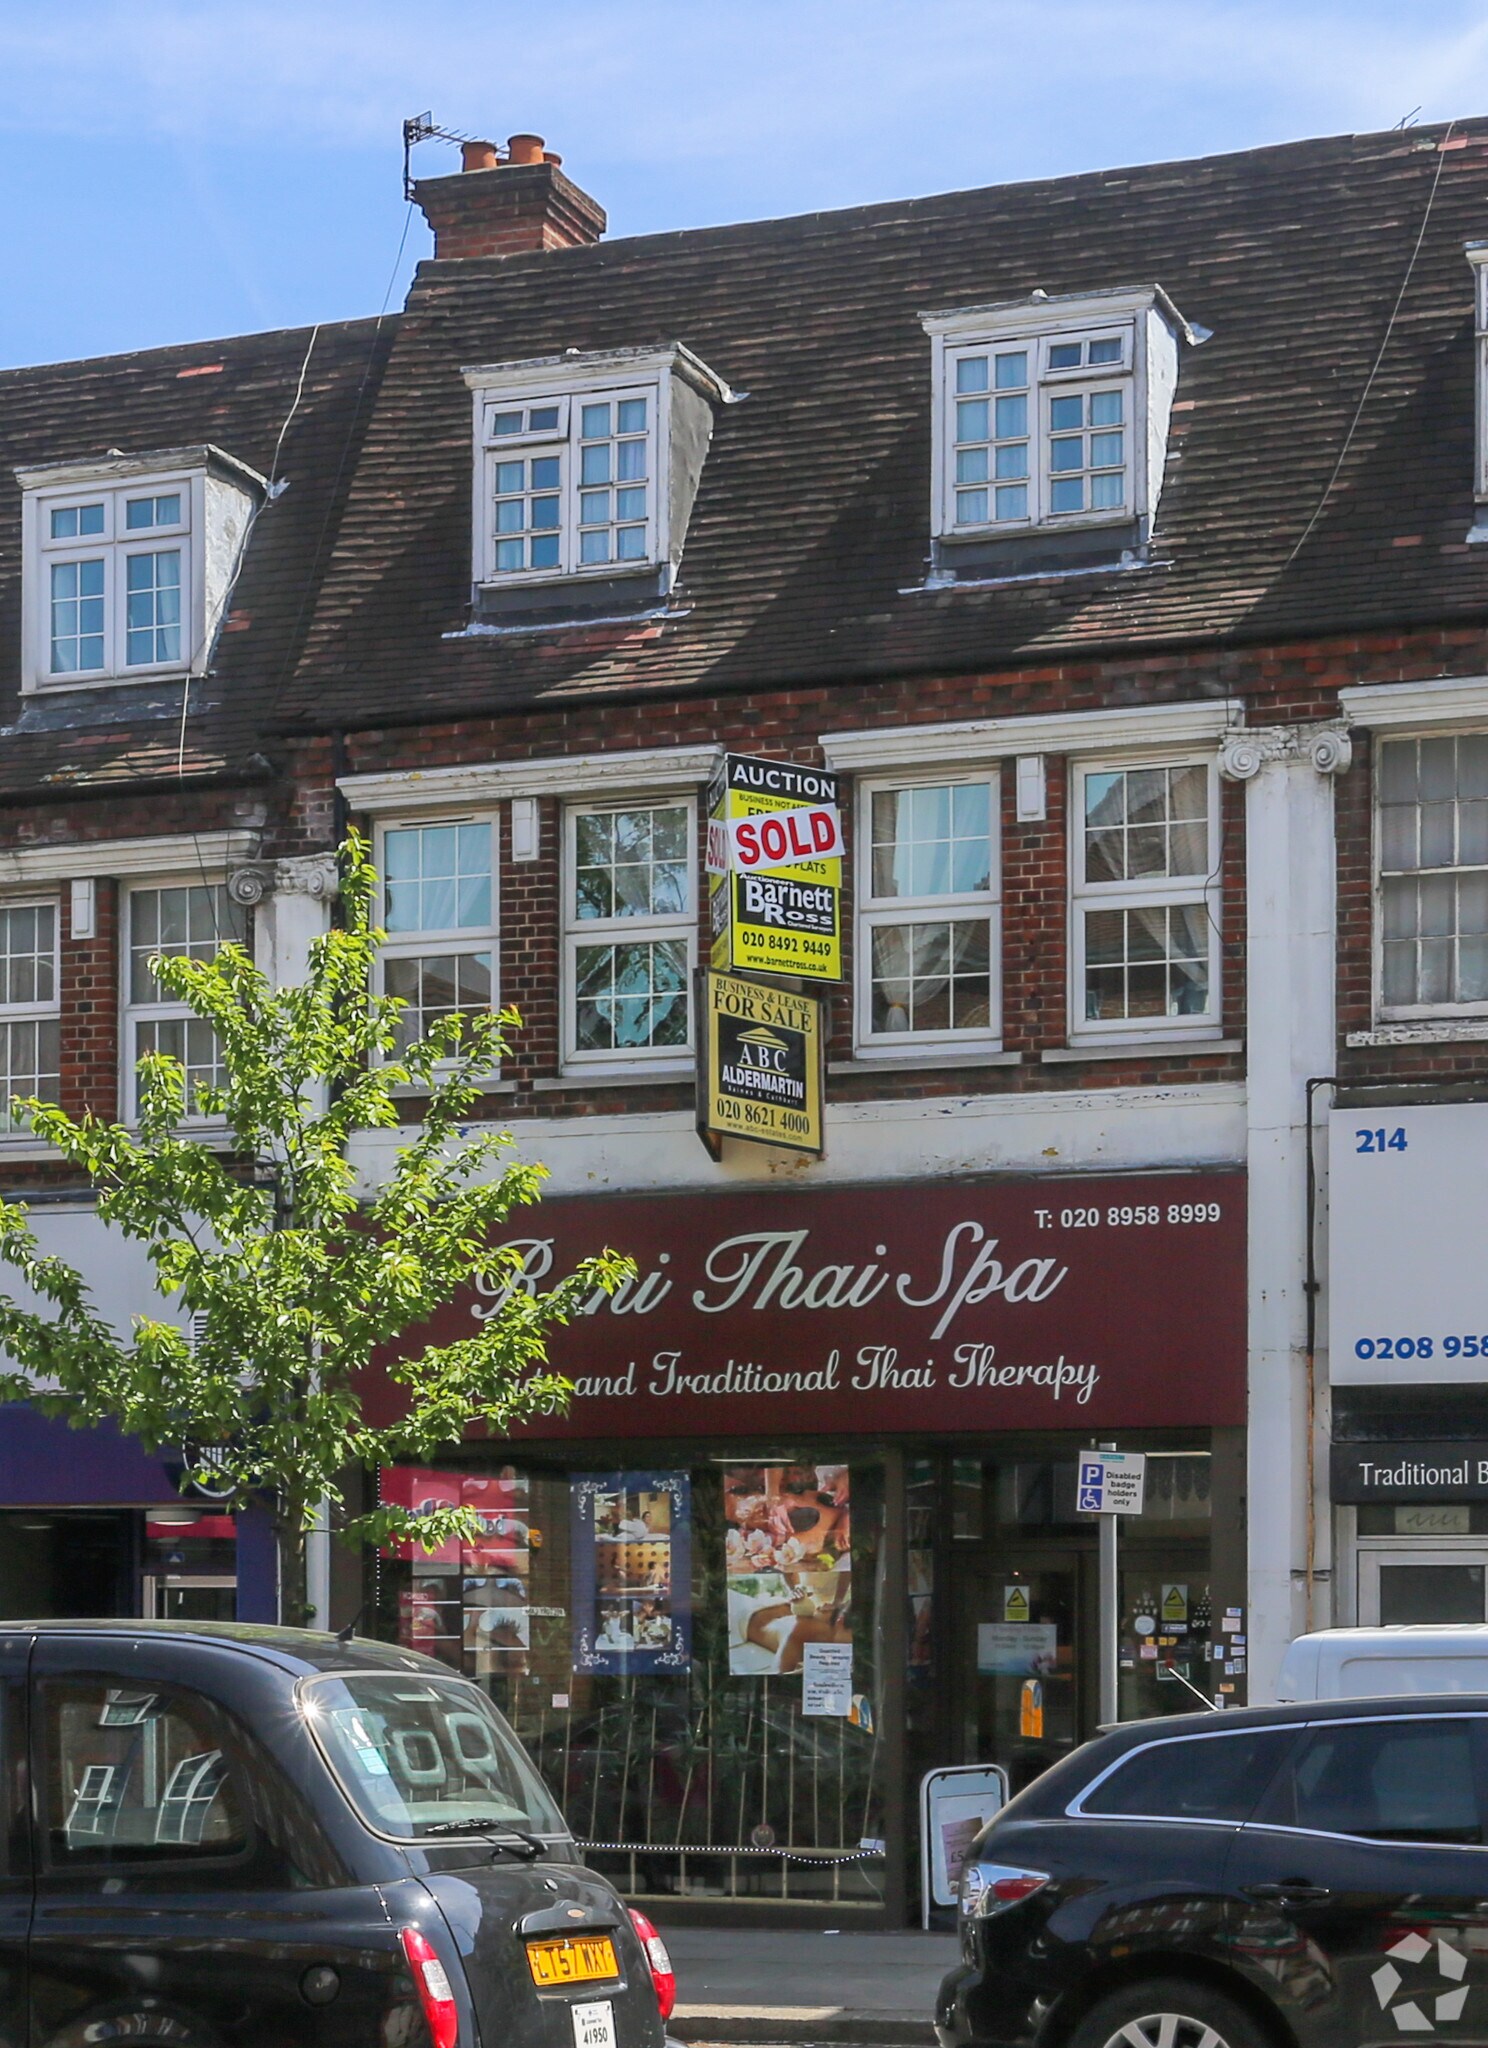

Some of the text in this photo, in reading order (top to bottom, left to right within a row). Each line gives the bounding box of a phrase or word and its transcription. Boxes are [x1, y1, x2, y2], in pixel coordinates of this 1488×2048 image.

[732, 764, 836, 799] AUCTION
[739, 793, 773, 806] BUSINESS
[736, 811, 836, 865] SOLD
[746, 880, 833, 913] Barnett
[764, 902, 833, 925] Ross
[742, 931, 831, 956] 020 8492 9449
[716, 978, 809, 1013] BUSINESS & LEASE
[714, 990, 812, 1033] FOR SALE
[722, 1064, 804, 1099] ALDERMARTIN
[717, 1098, 810, 1135] 020 8621 4000
[1356, 1127, 1408, 1153] 214
[1034, 1203, 1221, 1229] T: 020 8958 8999
[693, 1229, 890, 1313] Thai
[896, 1221, 1069, 1340] Spa
[1354, 1336, 1434, 1360] 0208
[574, 1361, 637, 1396] and
[648, 1350, 840, 1396] Traditional
[851, 1345, 936, 1391] Thai
[948, 1342, 1100, 1404] Therapy
[1106, 1471, 1142, 1480] Disabled
[1110, 1481, 1136, 1489] badge
[1359, 1460, 1468, 1486] Traditional
[1107, 1489, 1137, 1497] holders
[1112, 1498, 1130, 1506] only
[583, 2026, 608, 2045] 41950
